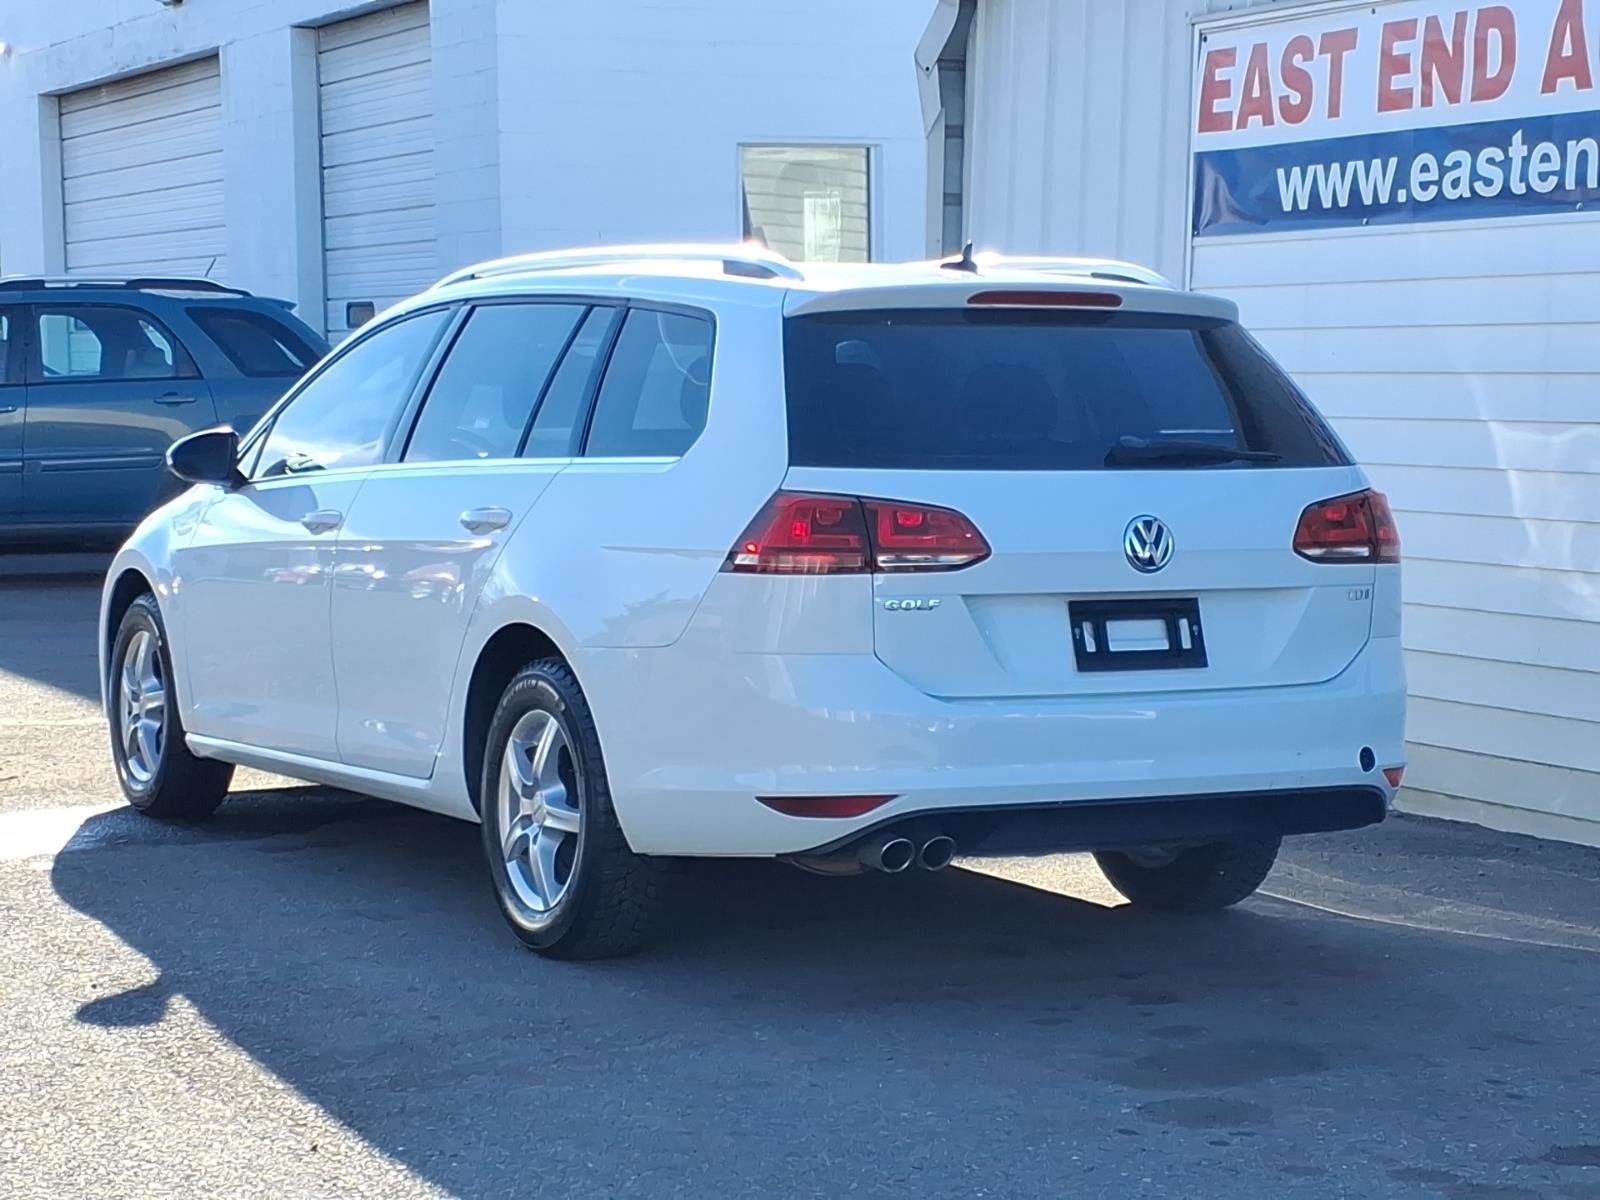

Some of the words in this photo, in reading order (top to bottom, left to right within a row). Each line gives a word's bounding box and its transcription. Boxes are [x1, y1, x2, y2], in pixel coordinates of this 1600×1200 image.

[1198, 27, 1359, 133] EAST
[1377, 5, 1517, 113] END
[1276, 129, 1599, 212] www.easten
[884, 599, 940, 611] GOLF
